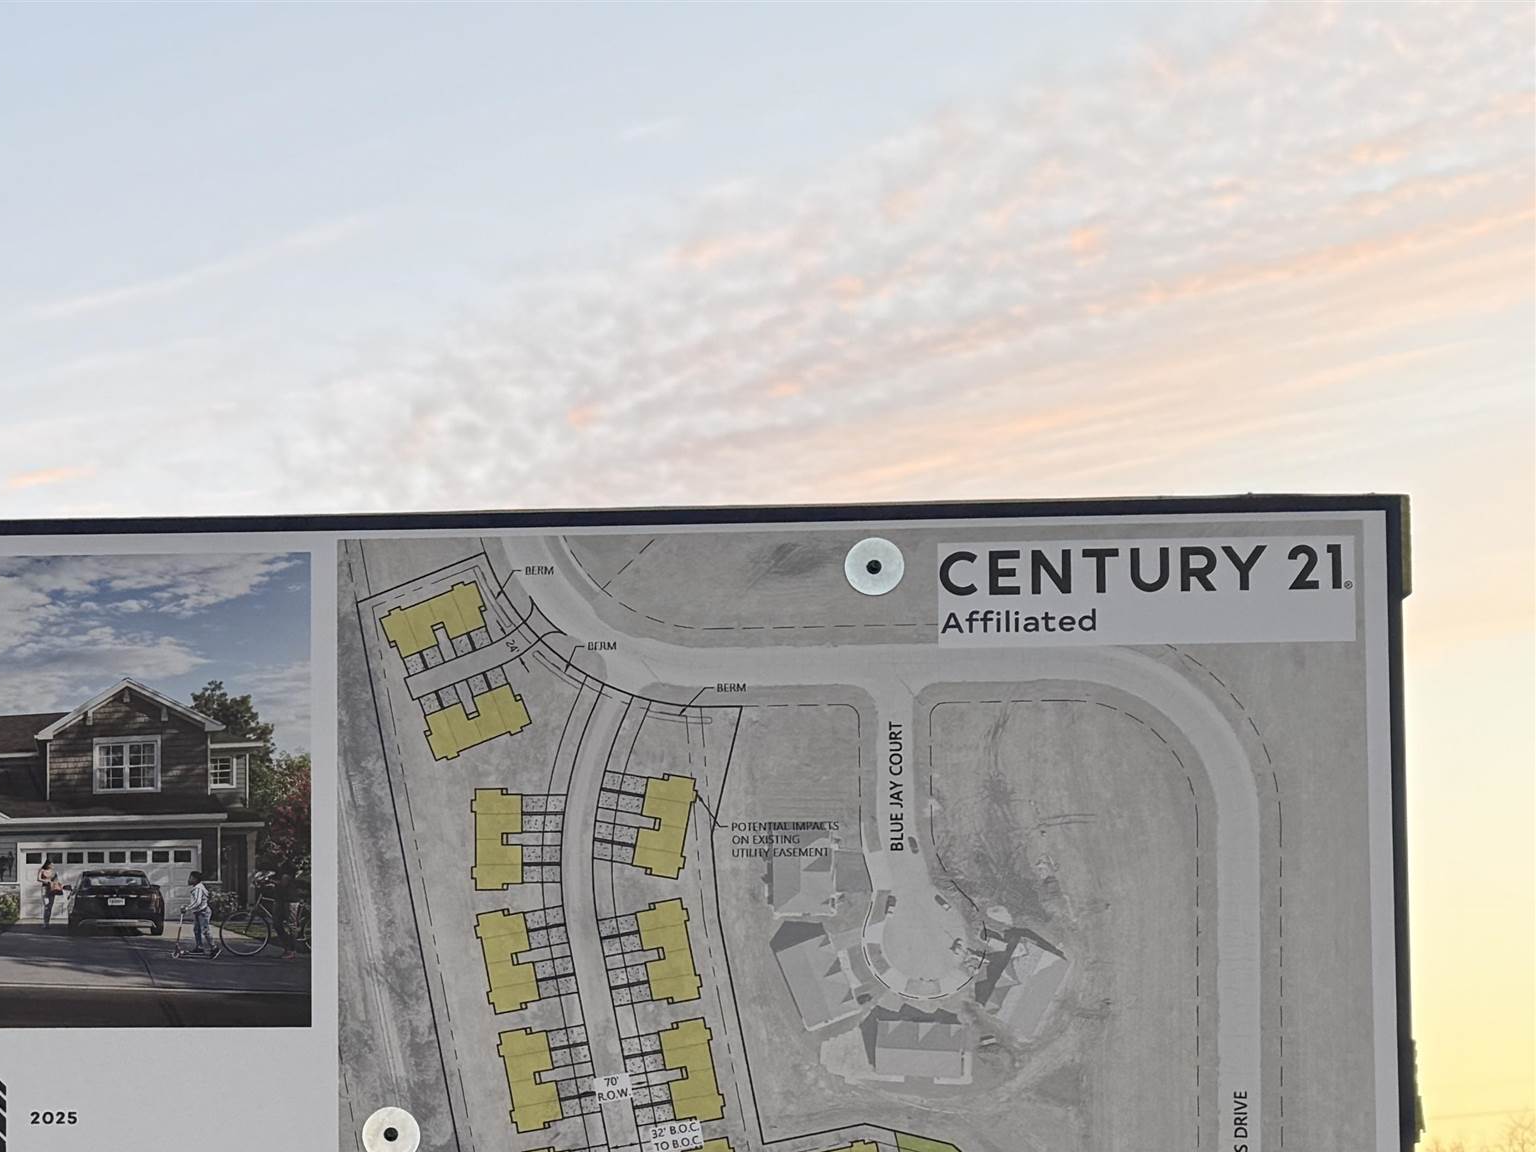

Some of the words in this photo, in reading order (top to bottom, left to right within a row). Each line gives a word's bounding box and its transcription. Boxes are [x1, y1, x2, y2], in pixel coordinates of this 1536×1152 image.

[525, 566, 554, 575] BERM
[939, 544, 1268, 596] CENTURY
[941, 608, 1098, 634] Affiliated
[587, 641, 617, 651] BERM
[716, 683, 746, 692] BERM
[888, 721, 903, 776] COURT
[889, 780, 904, 808] JAY
[731, 821, 789, 832] POTENTIAL
[792, 820, 839, 831] IMPACTS
[890, 813, 904, 851] BLUE
[731, 834, 750, 845] ON
[752, 834, 801, 845] EXISTING
[731, 847, 771, 858] UTILITY
[773, 847, 829, 858] EASEMENT
[604, 1076, 620, 1088] 70'
[597, 1087, 632, 1102] R.O.W.
[30, 1111, 78, 1125] 2025
[1232, 1091, 1248, 1138] DRIVE
[651, 1126, 667, 1140] 32'
[669, 1122, 701, 1136] B.O.C.
[654, 1141, 670, 1152] TO
[672, 1135, 703, 1149] B.O.C.
